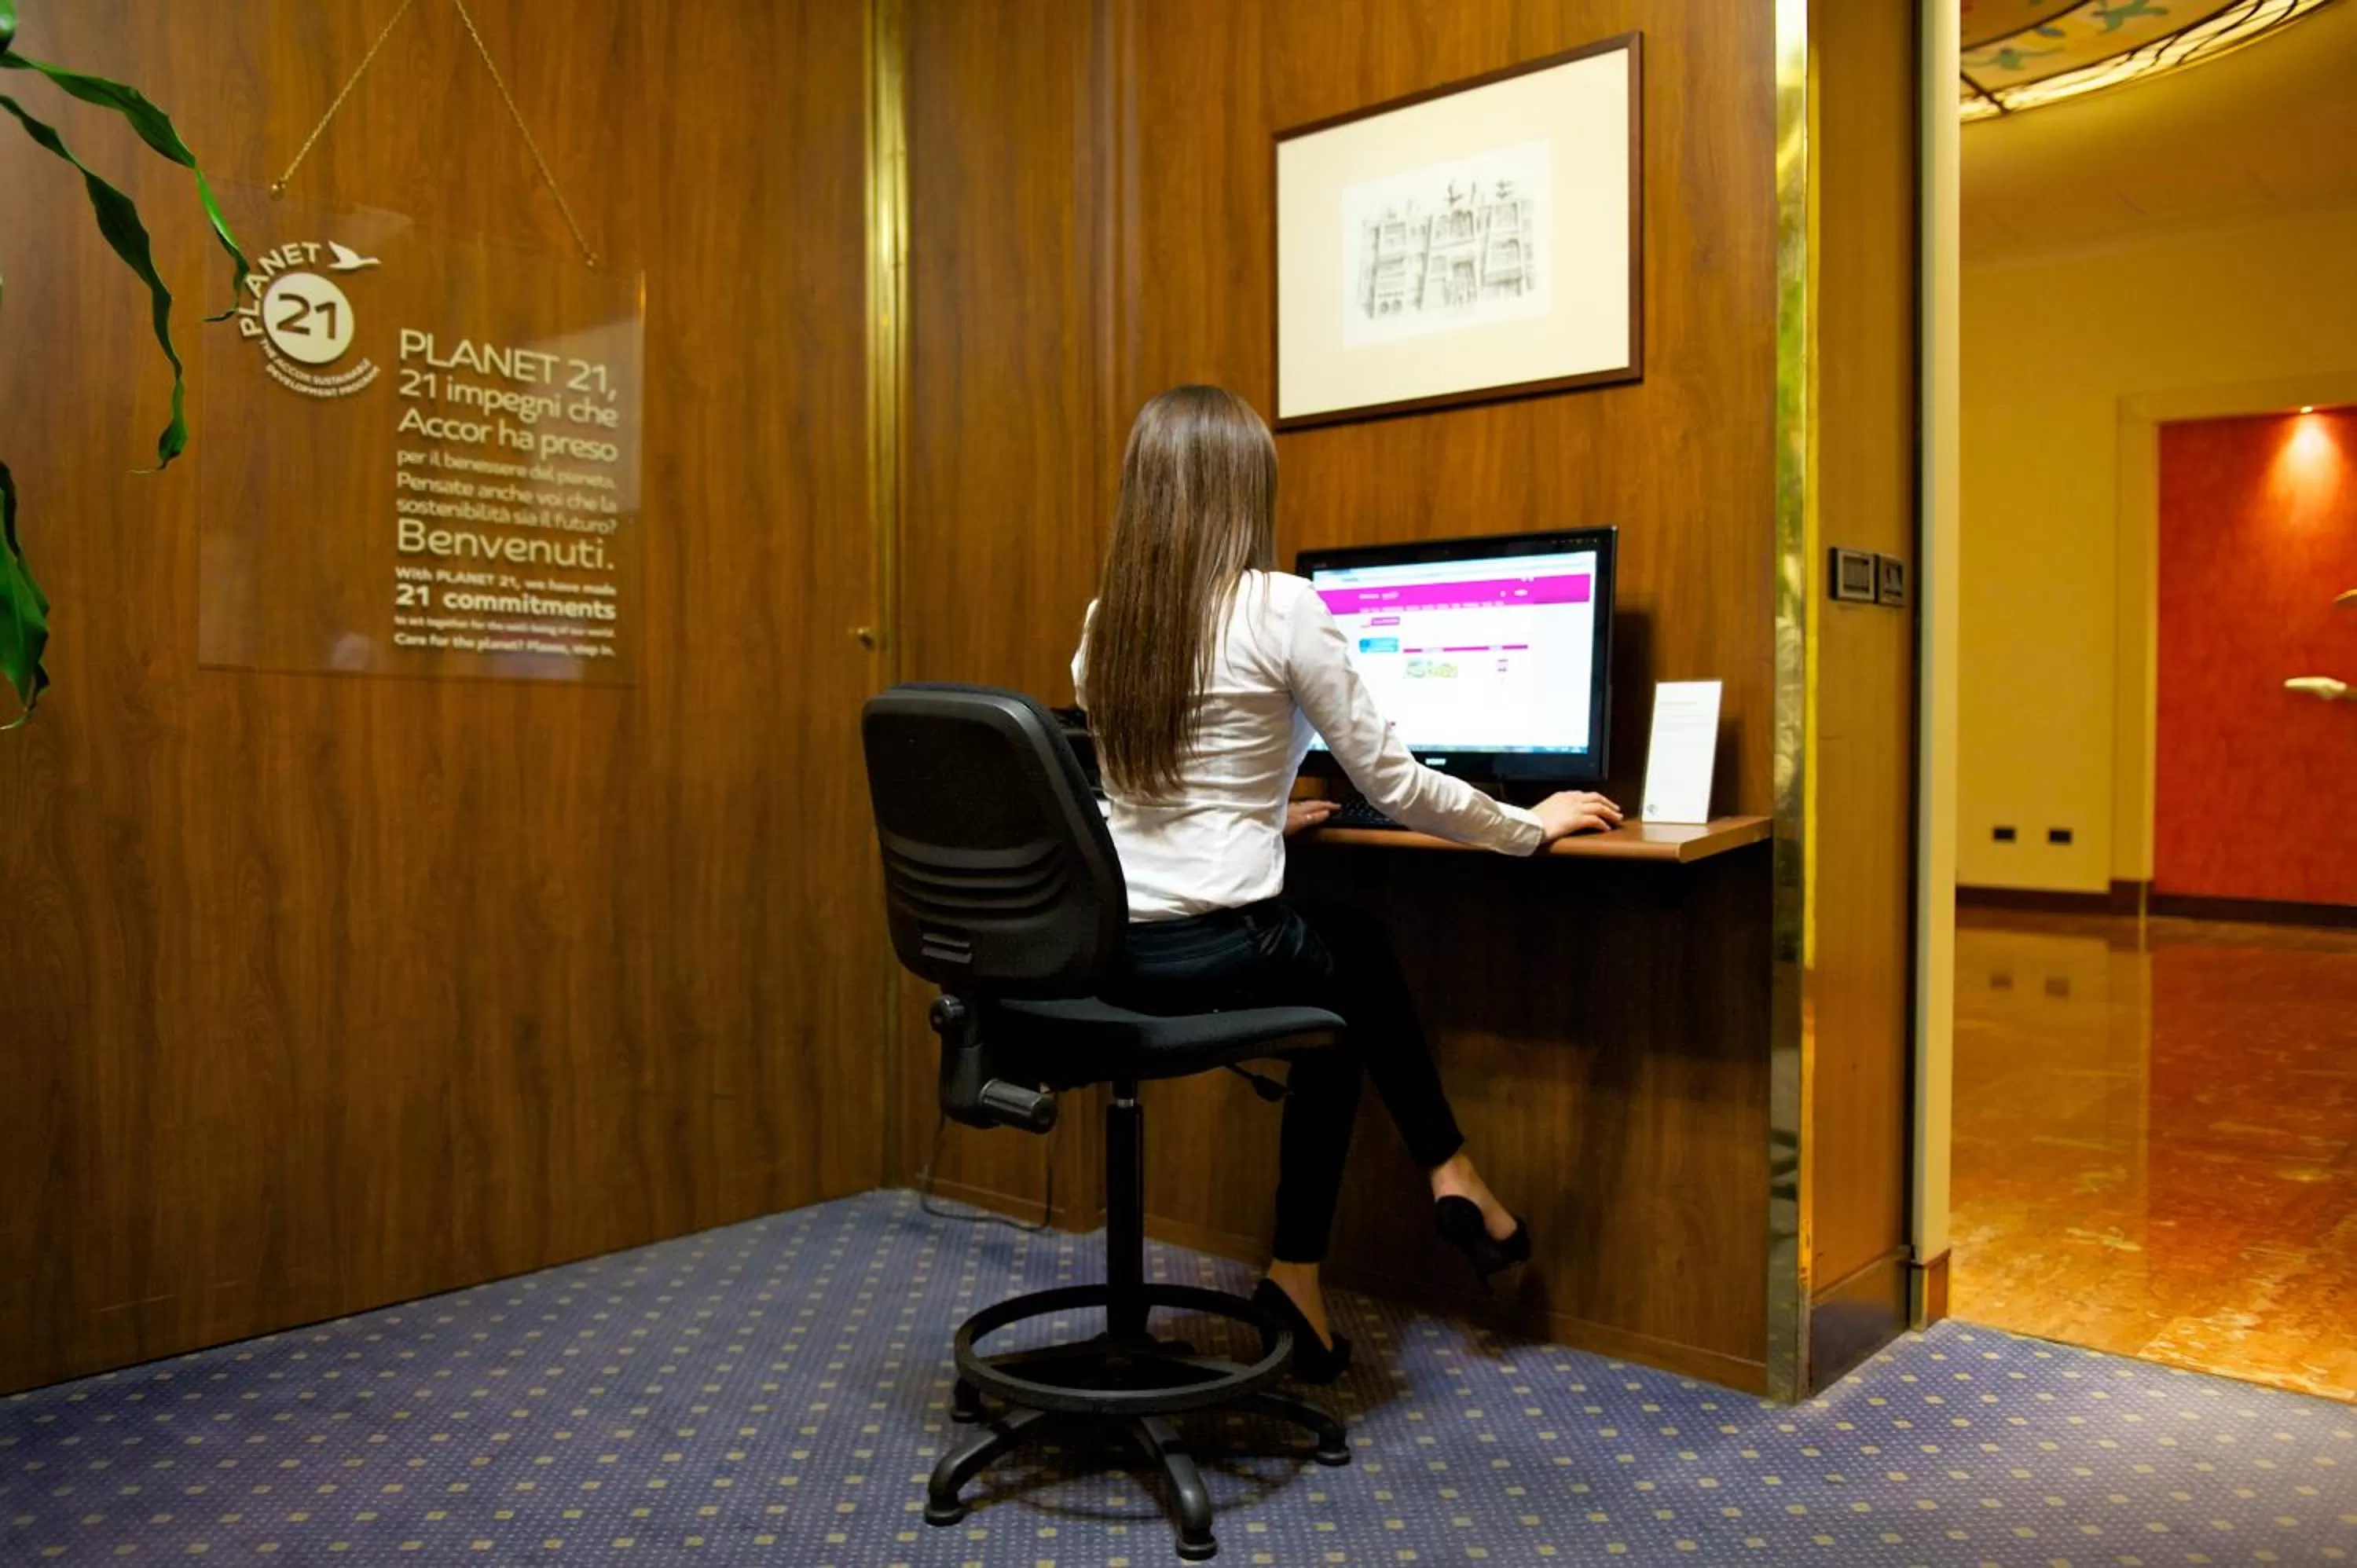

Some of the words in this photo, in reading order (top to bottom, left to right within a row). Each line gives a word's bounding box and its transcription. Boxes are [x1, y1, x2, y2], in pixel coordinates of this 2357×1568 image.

[239, 241, 321, 338] PLANET
[277, 293, 337, 339] 21
[400, 327, 559, 384] PLANET
[566, 358, 617, 402] 21,
[399, 368, 436, 398] 21
[446, 375, 560, 424] impegni
[567, 397, 618, 428] che
[397, 450, 426, 467] per
[429, 449, 440, 467] il
[398, 408, 493, 442] Accor
[498, 418, 534, 451] ha
[541, 434, 618, 462] preso
[397, 472, 475, 496] Pensate
[478, 484, 533, 505] anche
[398, 518, 615, 570] Benvenuti.
[395, 584, 430, 606] 21
[442, 592, 617, 620] commitments
[435, 570, 495, 586] PLANET
